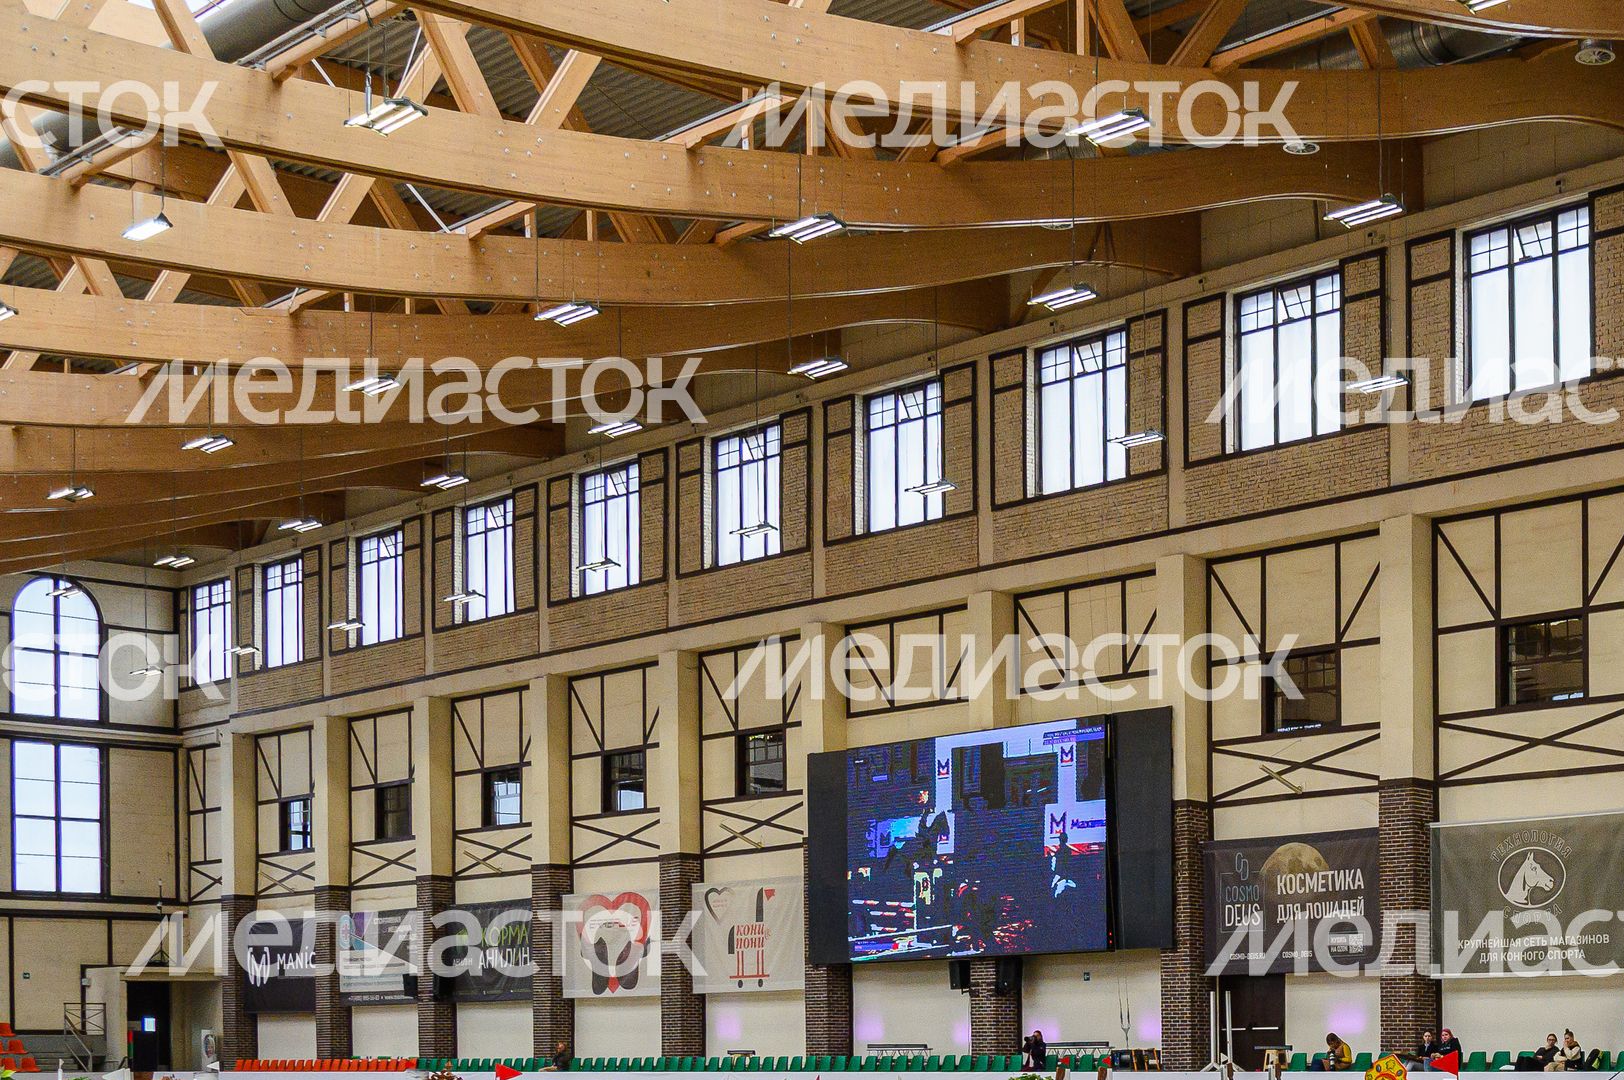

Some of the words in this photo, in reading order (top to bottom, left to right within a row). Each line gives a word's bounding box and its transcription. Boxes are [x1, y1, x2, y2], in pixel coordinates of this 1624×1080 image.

[1490, 830, 1573, 863] ТЕХНОЛОГИЯ
[1225, 884, 1260, 902] COSMO
[1277, 868, 1364, 895] КОСМЕТИКА
[1225, 903, 1261, 926] DEUS
[1276, 903, 1301, 923] ДЛЯ
[1305, 896, 1365, 920] ЛОШАДЕЙ
[481, 923, 529, 947] КОРМА
[1458, 936, 1522, 949] КРУПНЕЙШАЯ
[1523, 937, 1547, 948] СЕТЬ
[1549, 934, 1610, 946] МАГАЗИНОВ
[1479, 952, 1498, 964] ДЛЯ
[1501, 950, 1544, 962] КОННОГО
[1547, 948, 1586, 960] СПОРТА
